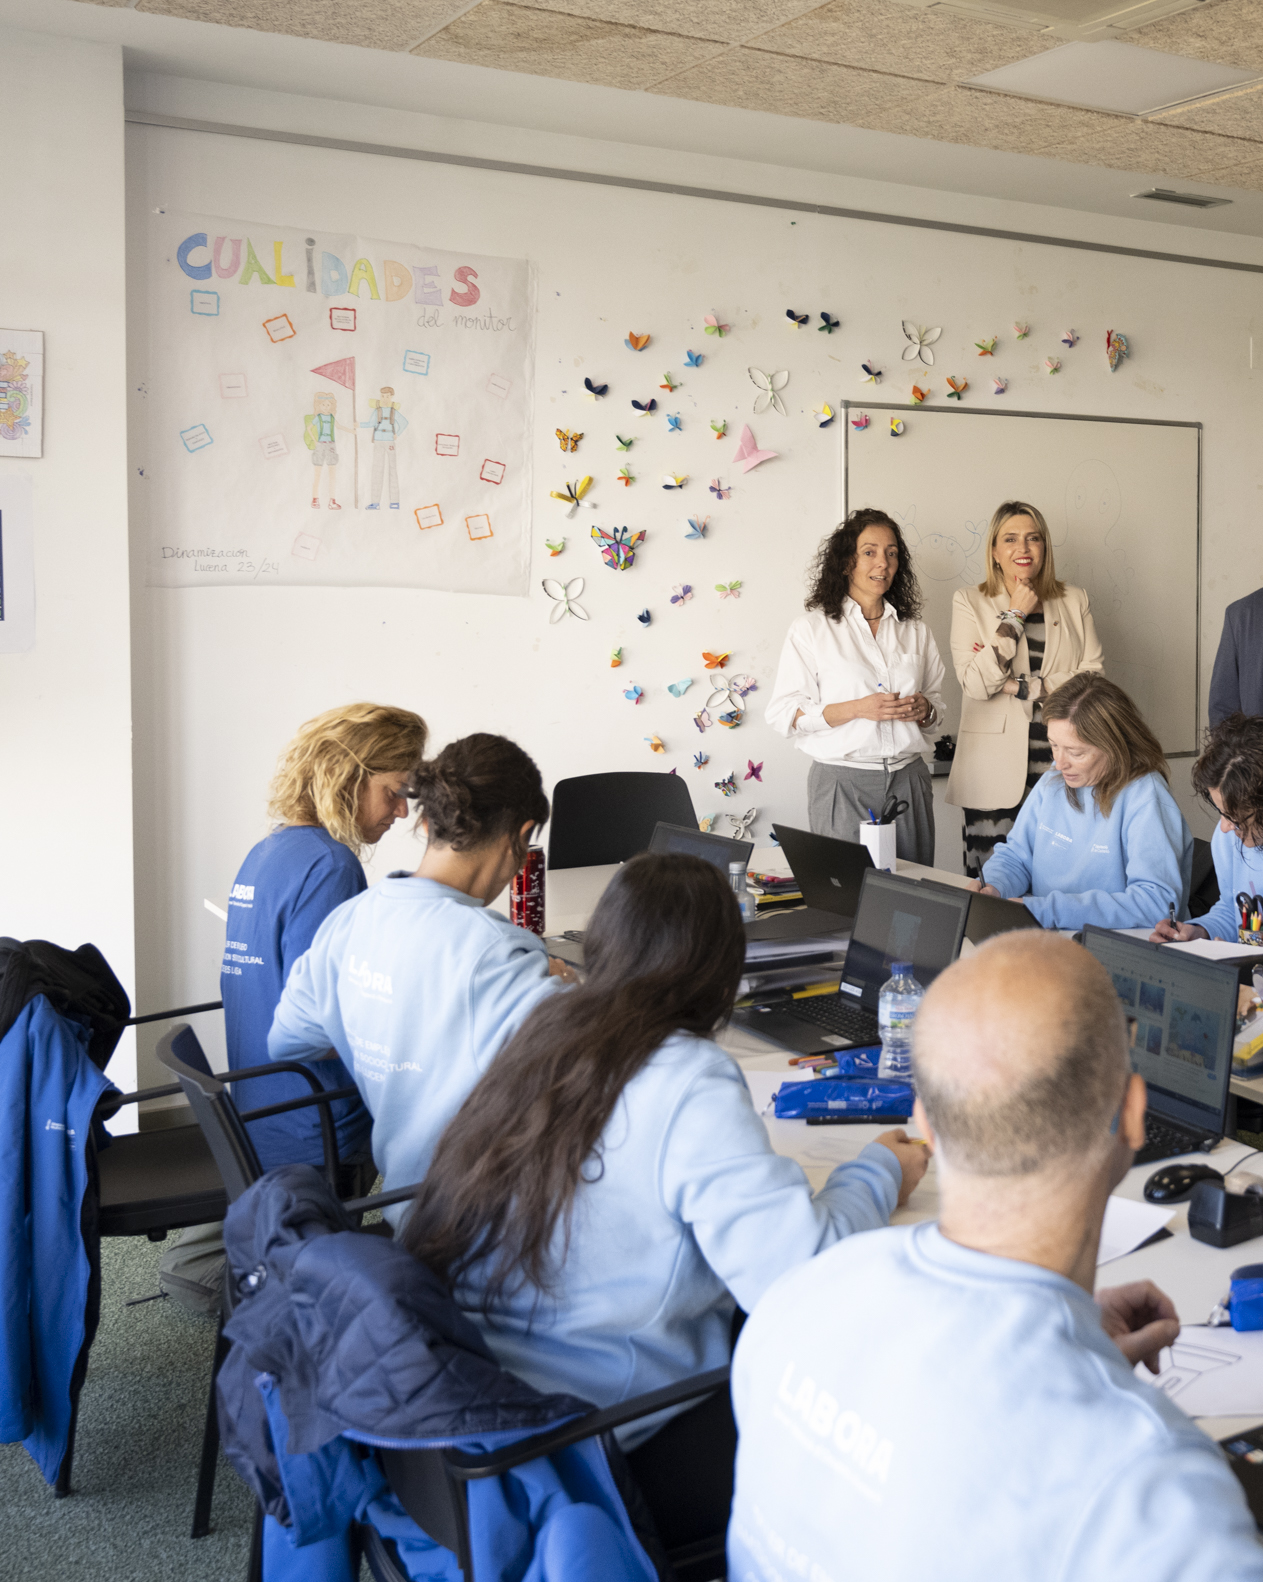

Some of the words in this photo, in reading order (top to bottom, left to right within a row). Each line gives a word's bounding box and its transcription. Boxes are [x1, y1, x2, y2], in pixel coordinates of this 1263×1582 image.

[177, 232, 481, 307] CUALIDADES
[416, 307, 444, 329] del
[453, 307, 516, 332] monitor
[193, 560, 229, 573] Lucena
[236, 557, 280, 580] 23/24
[777, 1360, 895, 1485] LABORA
